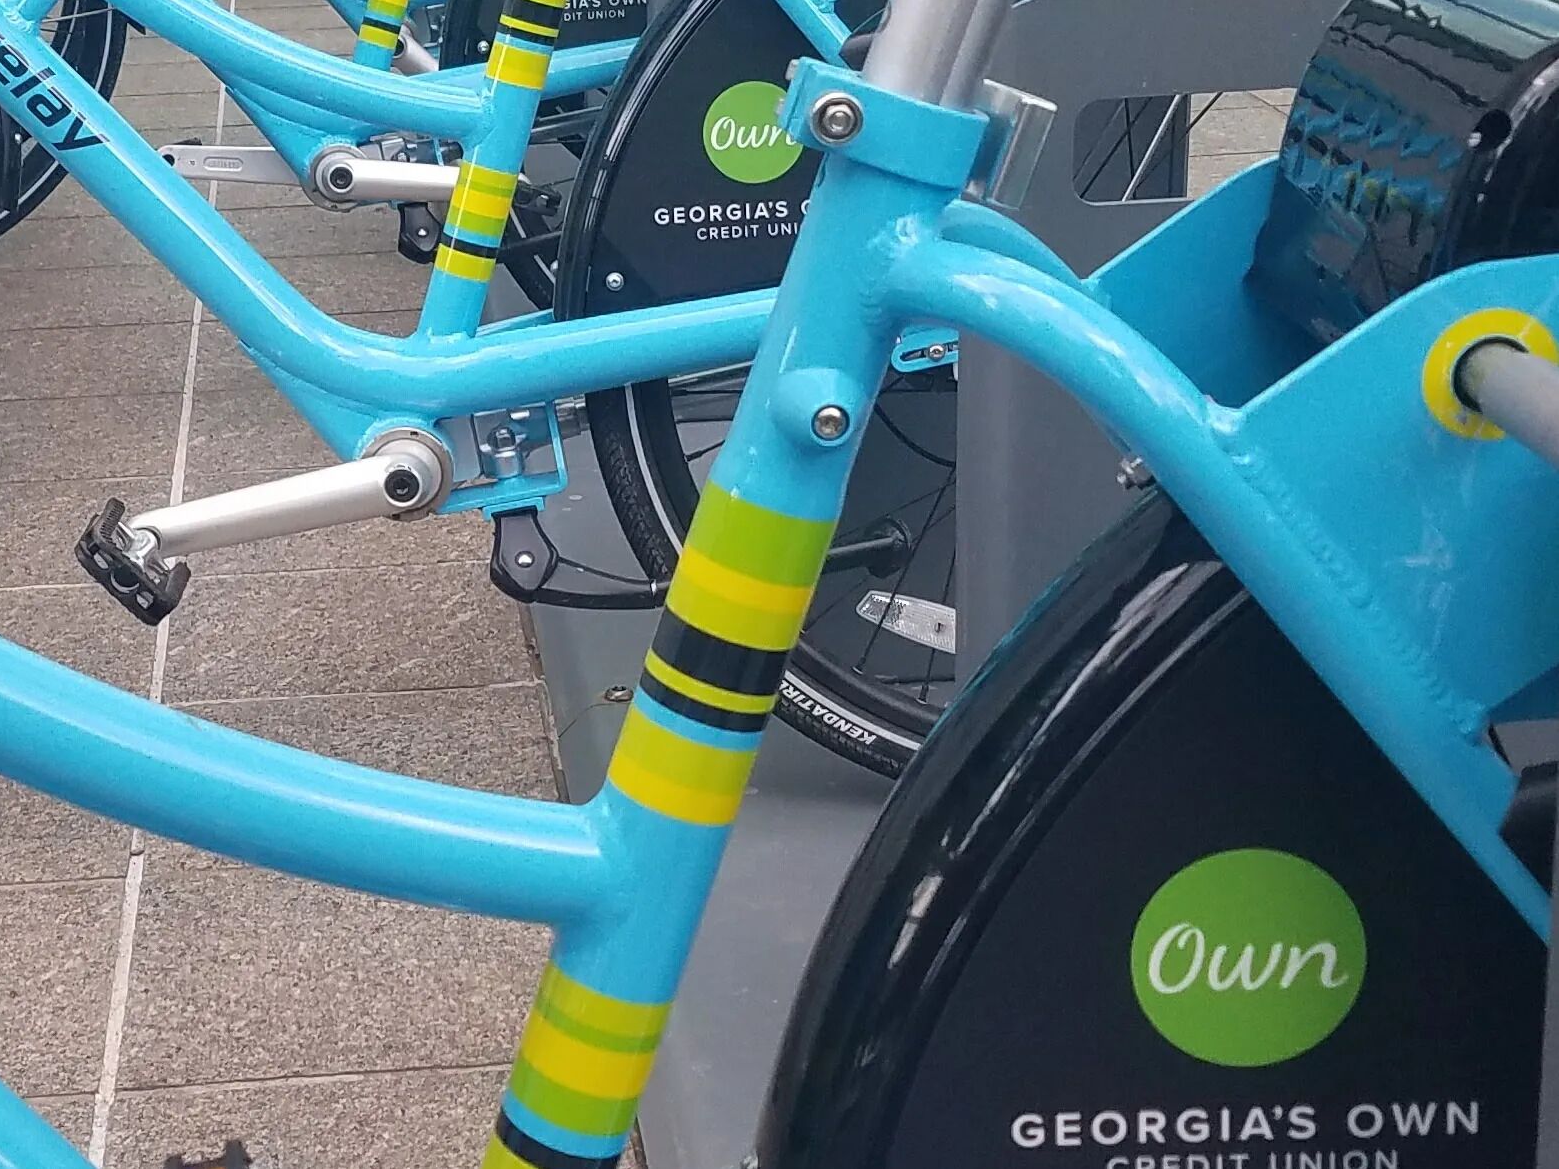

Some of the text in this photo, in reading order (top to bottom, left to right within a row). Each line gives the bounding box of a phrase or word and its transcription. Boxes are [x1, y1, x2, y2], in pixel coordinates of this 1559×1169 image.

[563, 9, 625, 21] DIT UNION
[710, 116, 797, 150] Own
[654, 200, 788, 225] GEORGIA'S
[696, 222, 798, 240] CREDIT UNI
[1148, 922, 1347, 996] Own
[1011, 1101, 1480, 1147] GEORGIA'S OWN
[1106, 1149, 1399, 1169] CREDIT UNION
